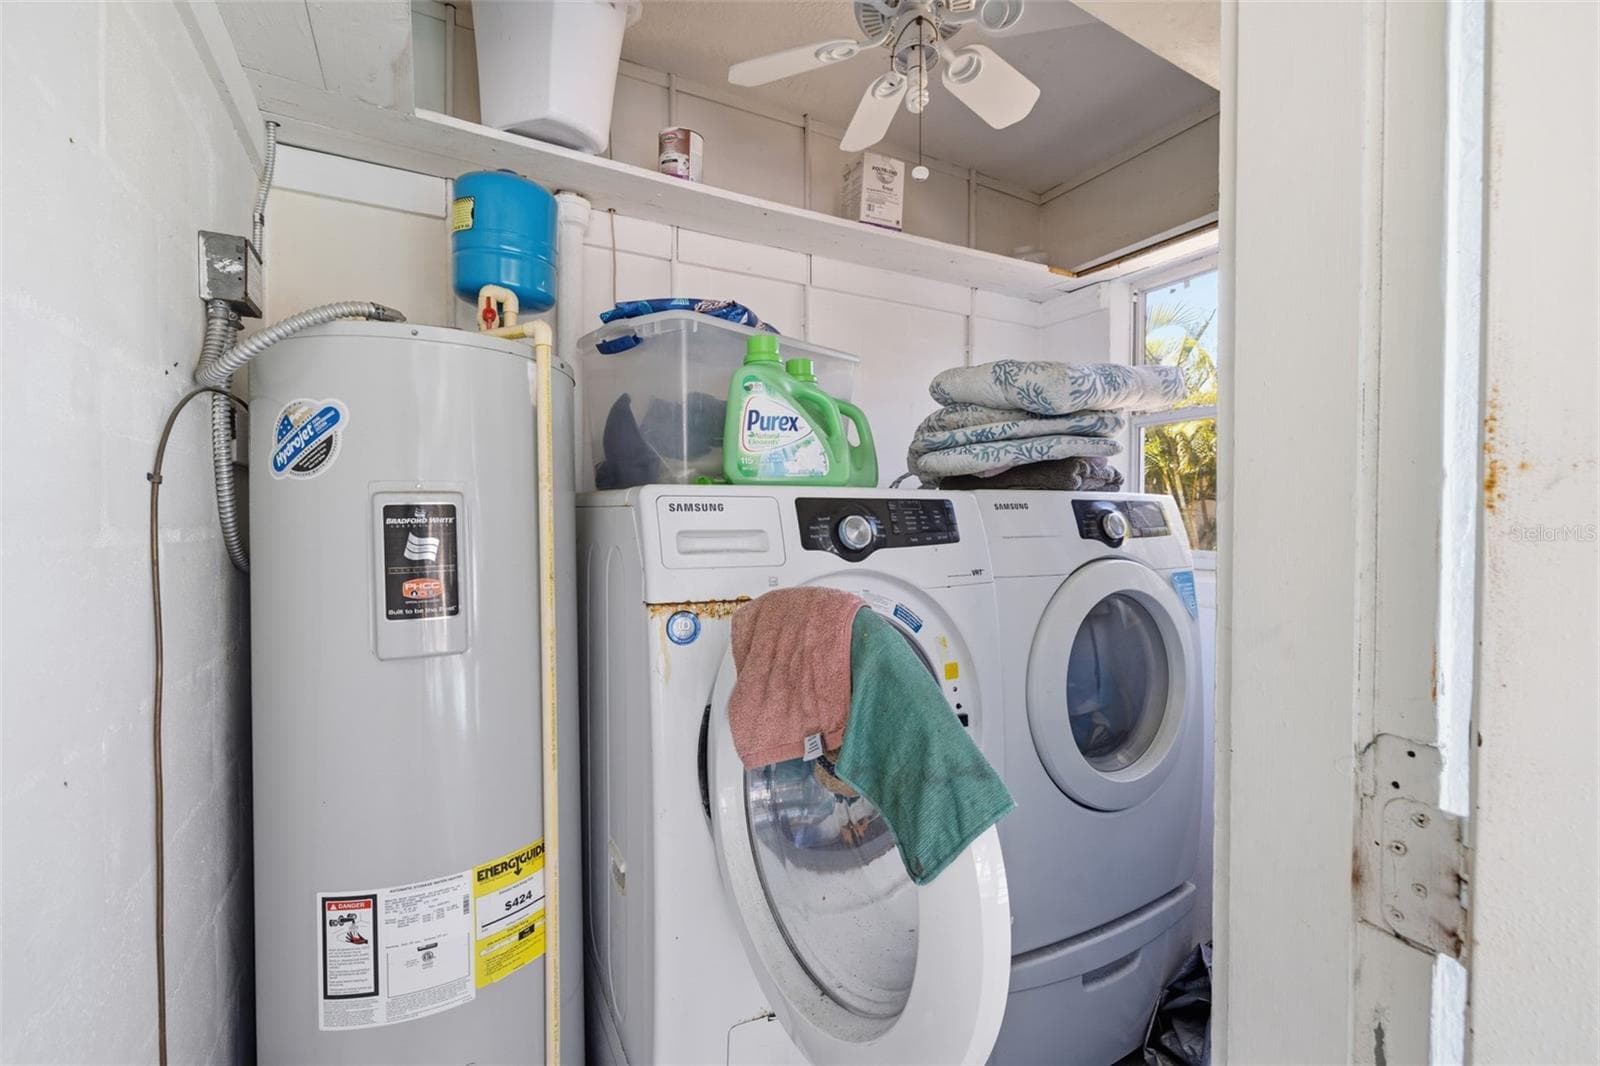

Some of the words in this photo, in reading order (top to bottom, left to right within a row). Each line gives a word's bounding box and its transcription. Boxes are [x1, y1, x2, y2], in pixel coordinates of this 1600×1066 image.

[747, 409, 799, 432] Purex
[275, 422, 315, 468] Hydrojet
[668, 503, 724, 512] SAMSUNG
[993, 503, 1029, 511] SAMSUNG
[386, 517, 428, 525] BRADFORD
[429, 516, 454, 524] WHITE
[388, 608, 404, 616] Built
[338, 902, 366, 910] DANGER
